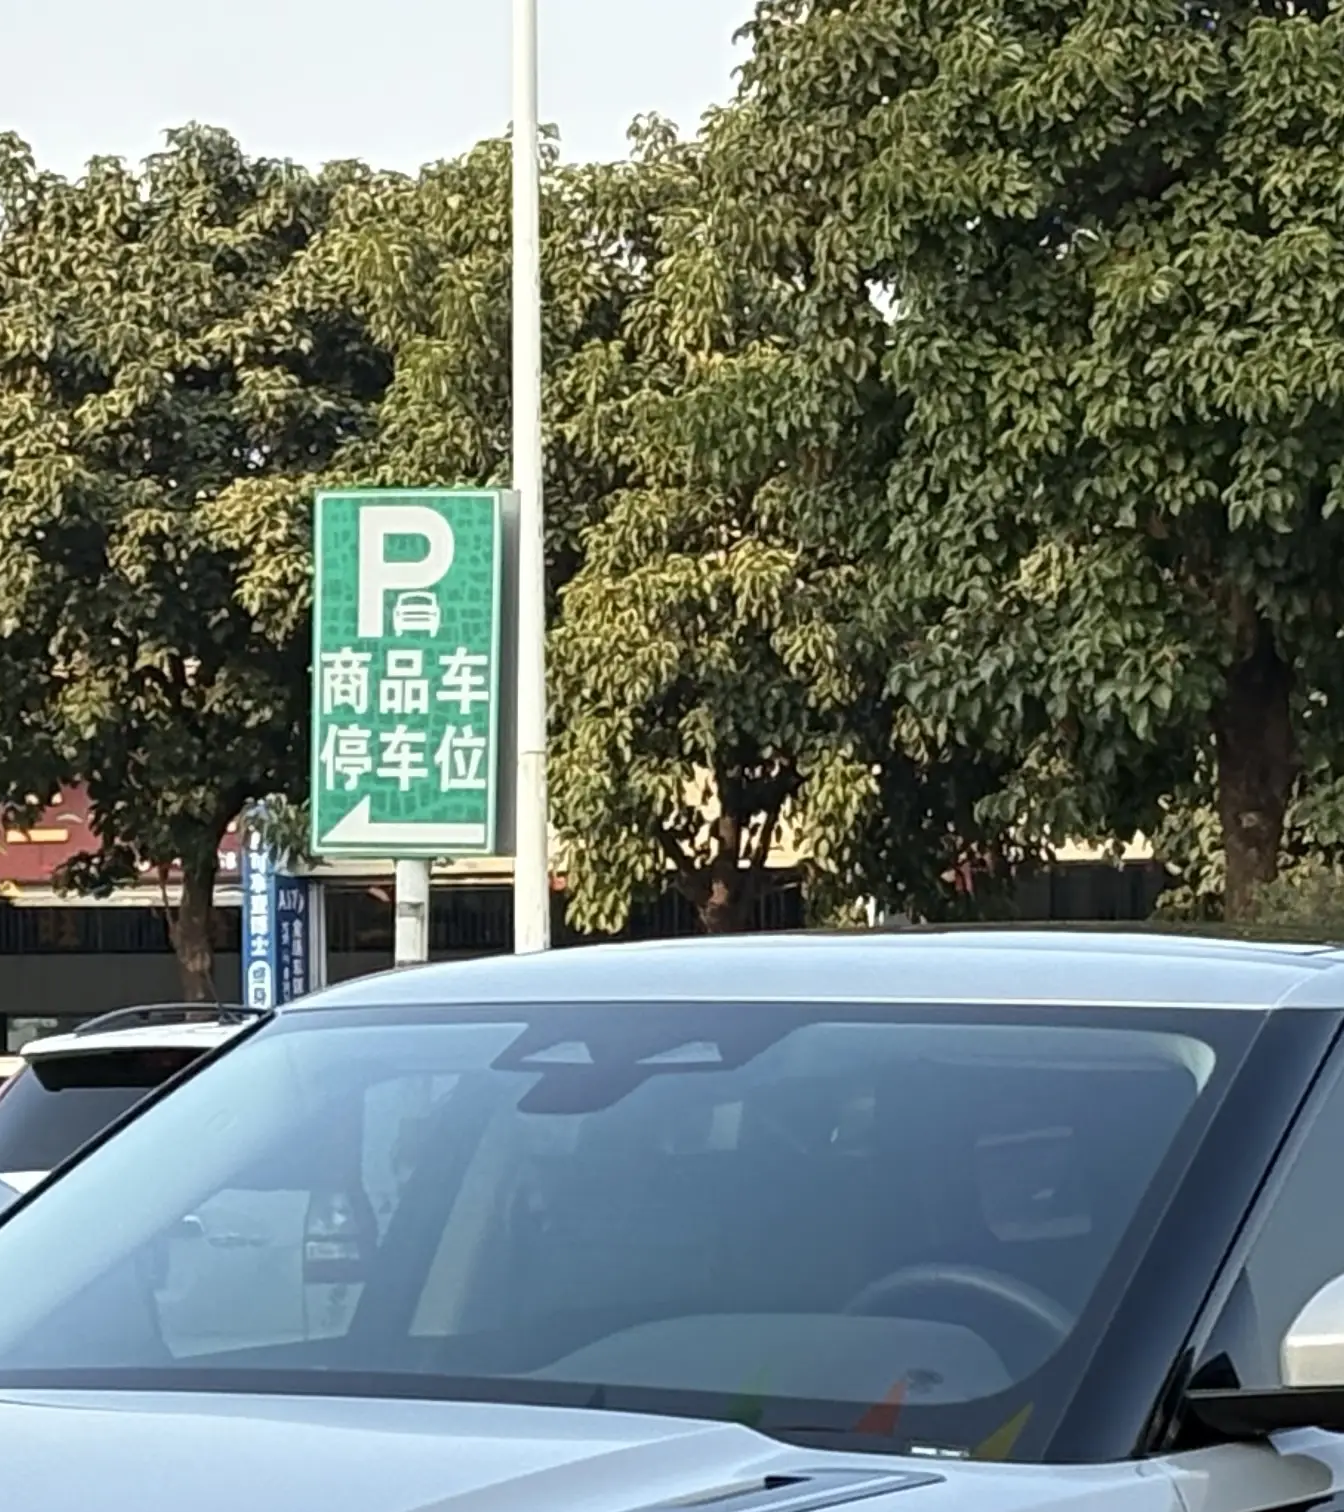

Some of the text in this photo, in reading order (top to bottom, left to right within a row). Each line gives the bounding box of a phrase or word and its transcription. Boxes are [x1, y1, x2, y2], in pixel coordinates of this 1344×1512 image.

[356, 504, 455, 639] P
[320, 646, 490, 715] 商品车
[319, 724, 487, 793] 停车位
